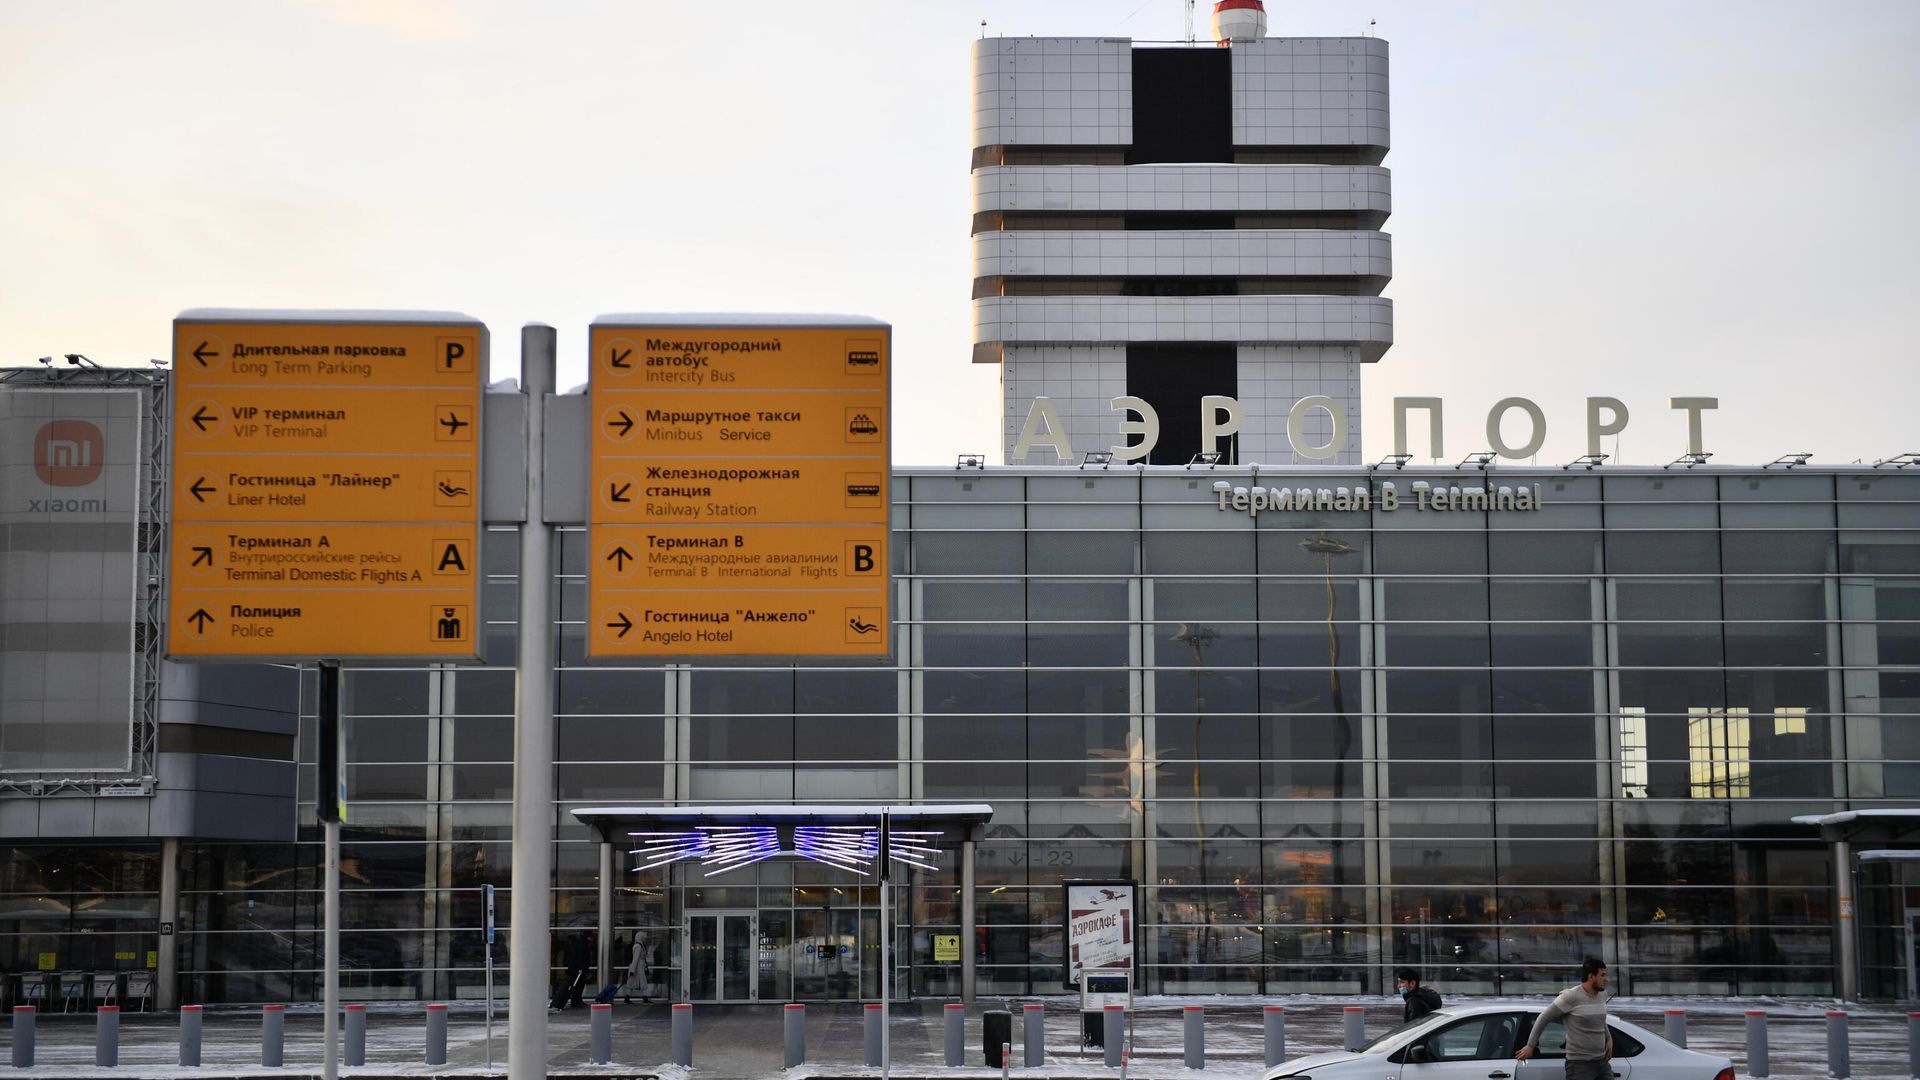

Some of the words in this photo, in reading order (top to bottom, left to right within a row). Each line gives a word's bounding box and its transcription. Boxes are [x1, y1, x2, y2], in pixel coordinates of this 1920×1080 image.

[232, 344, 329, 358] Длительная
[334, 346, 406, 357] парковка
[647, 339, 780, 353] Междугородний
[646, 353, 708, 369] автобус
[232, 361, 267, 376] Long
[274, 361, 311, 374] Term
[318, 361, 371, 377] Parking
[646, 369, 704, 384] Intercity
[711, 369, 735, 382] Bus
[232, 407, 258, 419] VIP
[264, 410, 345, 421] терминал
[646, 410, 750, 425] Маршрутное
[757, 412, 800, 421] такси
[234, 425, 258, 437] VIP
[264, 425, 327, 438] Terminal
[646, 428, 703, 440] Minibus
[720, 428, 771, 440] Service
[1010, 395, 1718, 460] АЭРОПОРТ
[229, 473, 316, 487] Гостиница
[323, 474, 399, 487] "Лайнер"
[646, 467, 799, 482] Железнодорожная
[228, 494, 264, 505] Liner
[269, 494, 305, 505] Hotel
[646, 487, 710, 498] станция
[1213, 482, 1370, 517] Терминал
[1412, 481, 1542, 511] Terminal
[646, 502, 700, 519] Railway
[707, 503, 756, 516] Station
[228, 535, 311, 550] Терминал
[647, 536, 728, 550] Терминал
[766, 554, 838, 563] авиалинии
[224, 568, 285, 580] Terminal
[290, 568, 356, 581] Domestic
[361, 569, 407, 584] Flights
[647, 565, 696, 577] Terminal
[719, 566, 791, 576] International
[801, 566, 838, 579] Flights
[231, 605, 301, 619] Полиция
[645, 610, 729, 624] Гостиница
[736, 610, 815, 622] "Анжело"
[232, 624, 274, 637] Police
[643, 630, 691, 645] Angelo
[697, 630, 732, 641] Hotel
